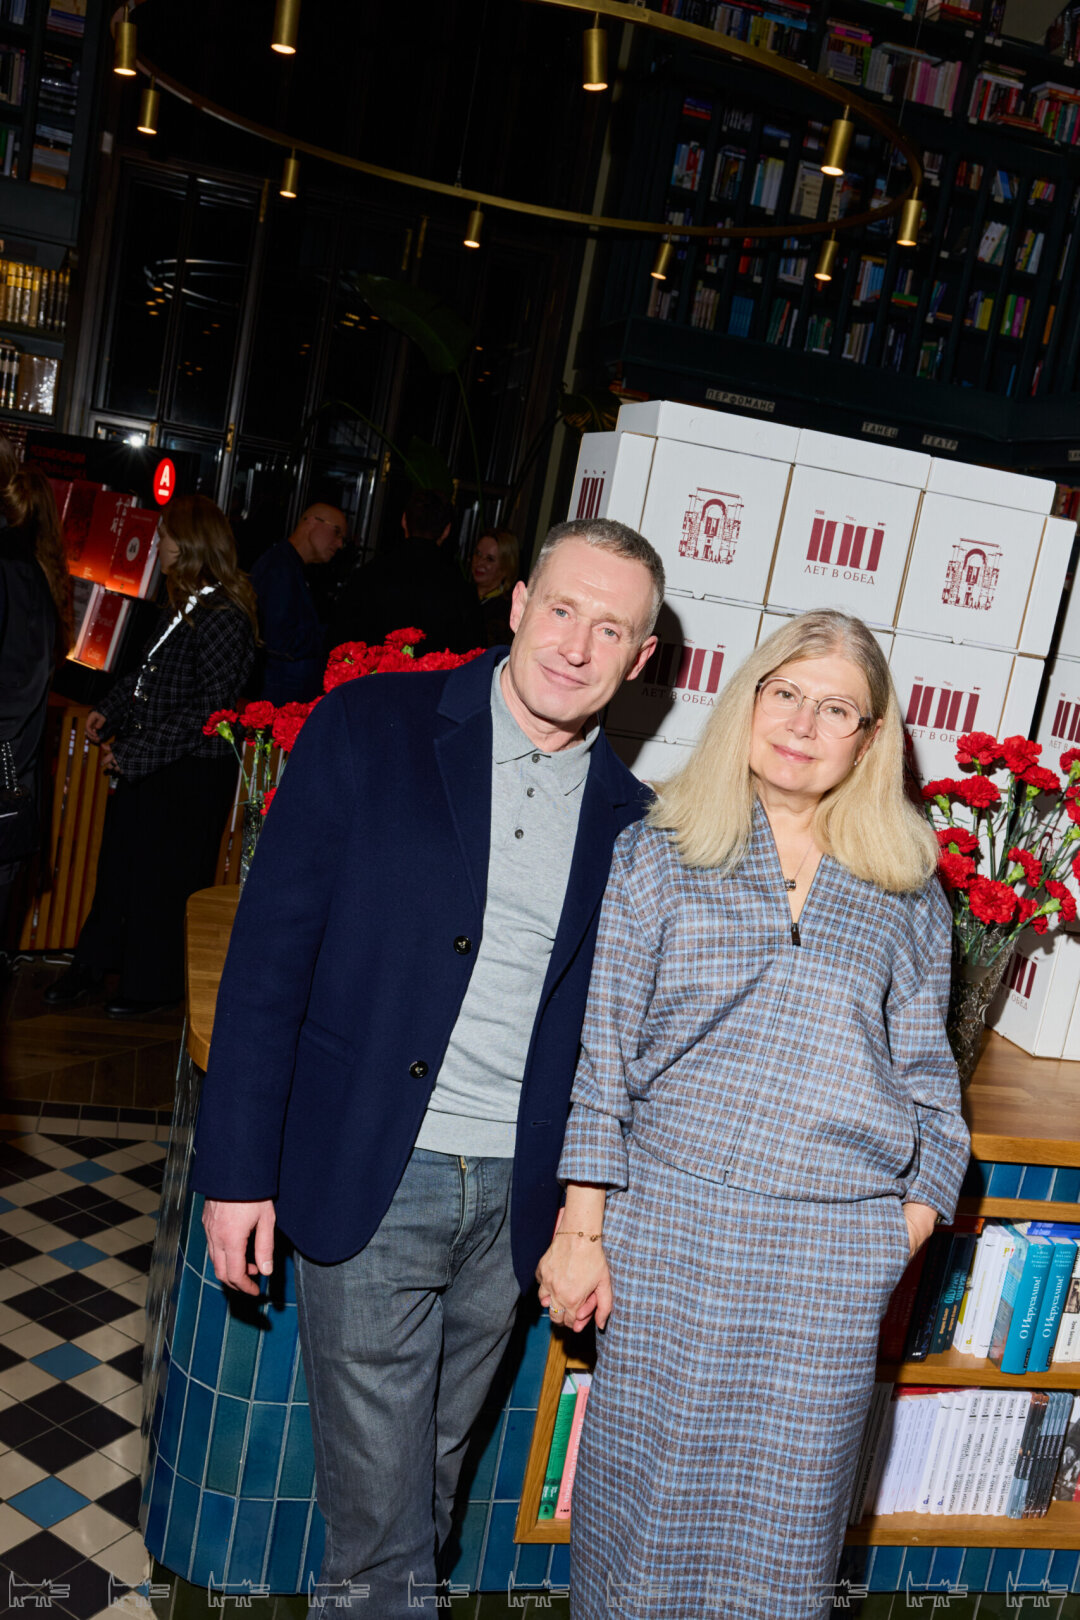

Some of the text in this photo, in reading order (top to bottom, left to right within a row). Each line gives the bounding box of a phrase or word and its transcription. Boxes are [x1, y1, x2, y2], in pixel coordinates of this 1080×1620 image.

[707, 389, 774, 411] ПЕРФОМАНС
[804, 564, 875, 585] ЛЕТ В ОБЕД
[682, 693, 715, 707] ОБЕД
[908, 728, 961, 743] ЕТ В ОБ
[1021, 1276, 1042, 1329] Иерусалим!
[1044, 1275, 1064, 1327] Иерусалим!
[1019, 1329, 1029, 1339] О
[1042, 1328, 1052, 1338] О
